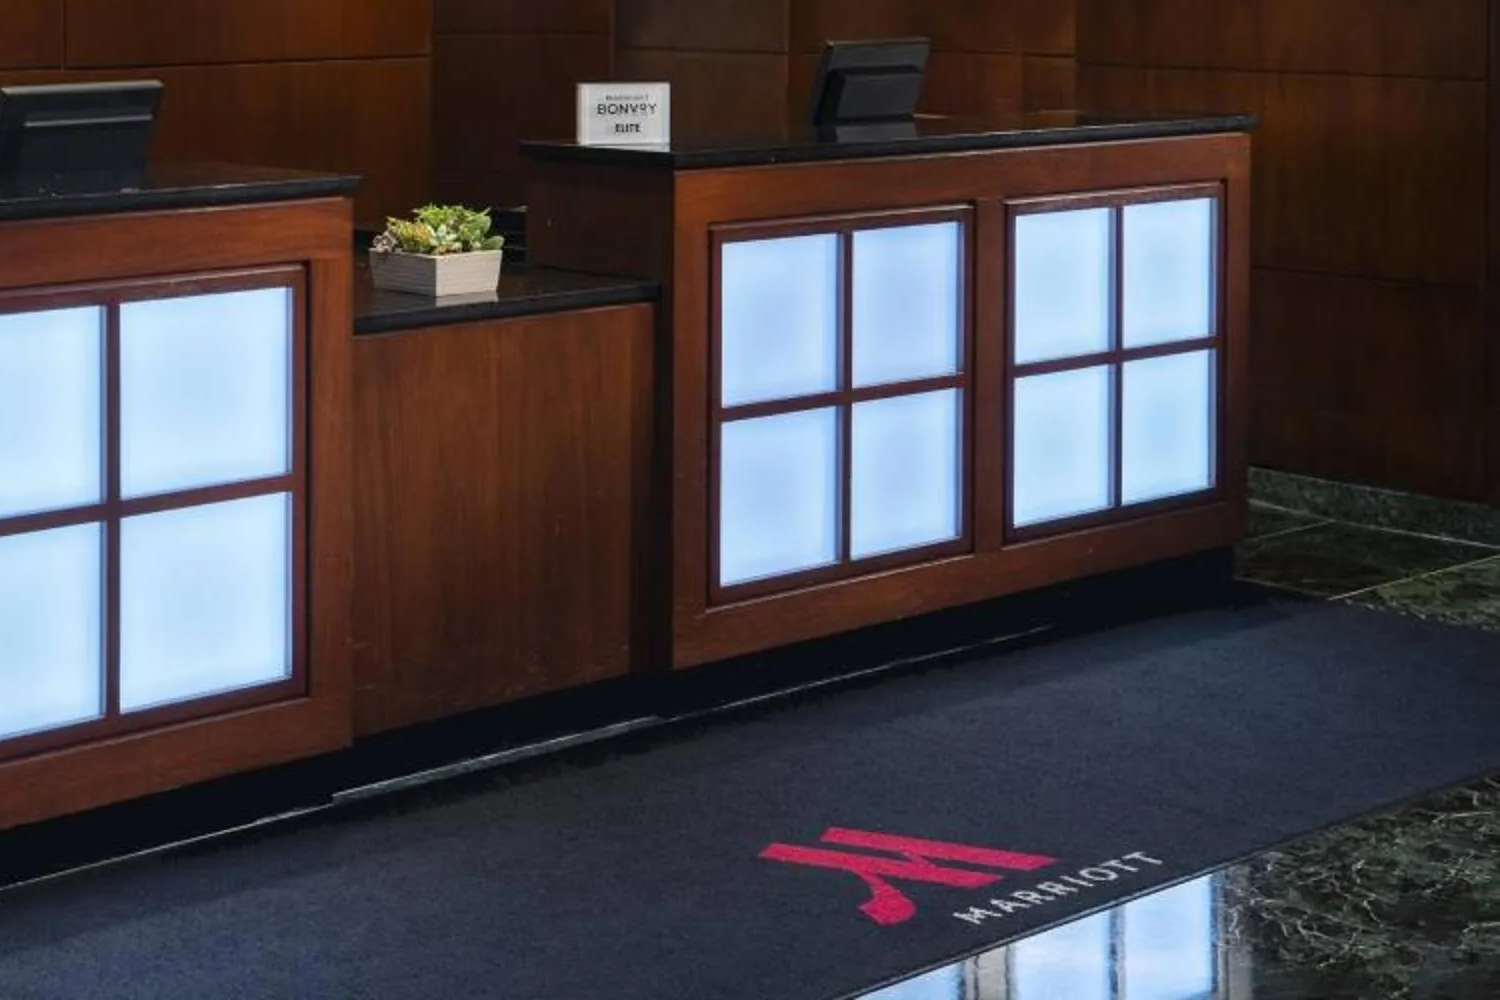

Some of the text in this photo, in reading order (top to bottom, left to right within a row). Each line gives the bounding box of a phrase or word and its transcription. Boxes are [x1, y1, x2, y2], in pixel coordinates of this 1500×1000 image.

[597, 103, 657, 115] BONVOY
[615, 123, 641, 133] ELITE
[952, 850, 1163, 925] MARRIOTT
